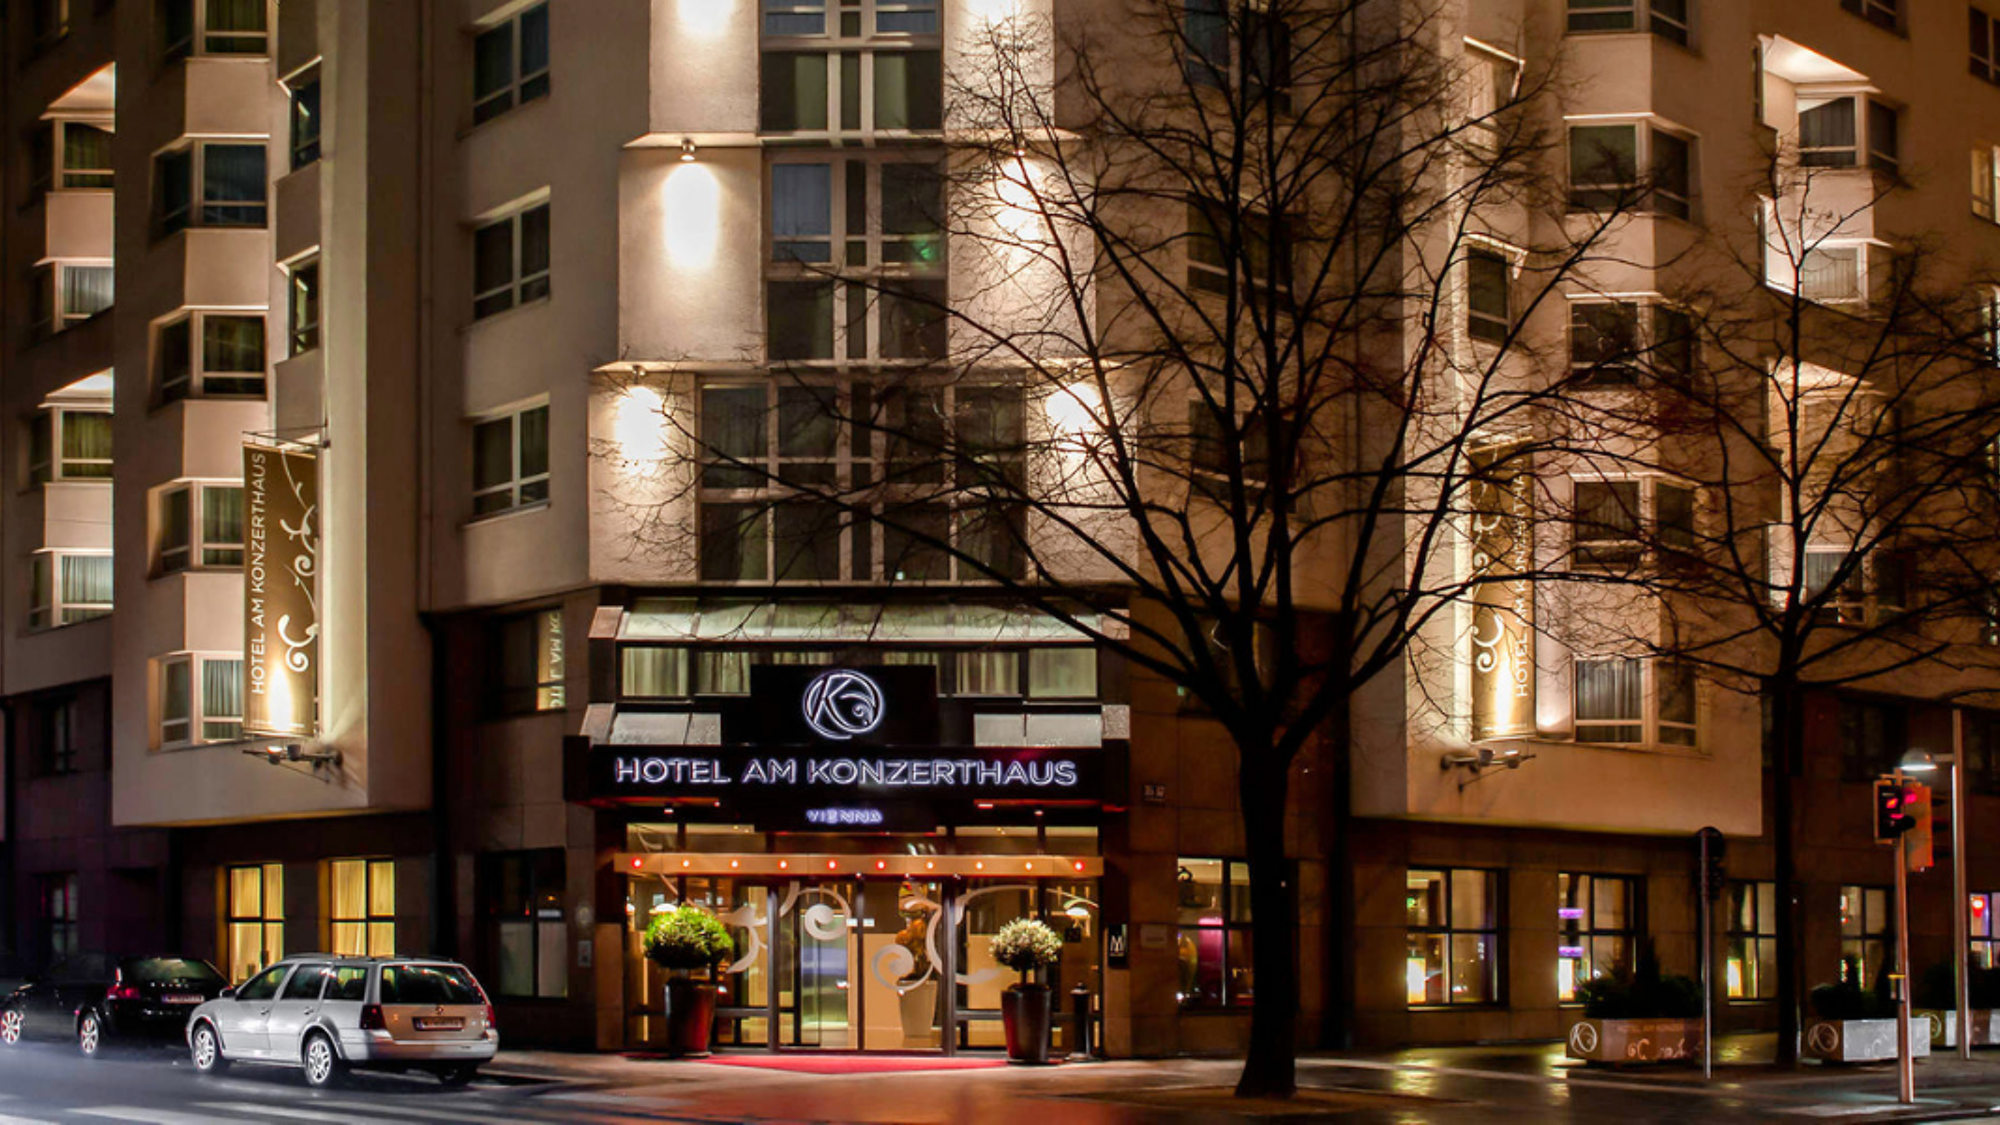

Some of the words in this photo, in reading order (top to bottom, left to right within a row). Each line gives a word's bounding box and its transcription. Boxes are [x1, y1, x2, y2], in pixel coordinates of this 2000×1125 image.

[251, 453, 266, 593] KONZERTHAUS
[251, 599, 265, 628] AM
[251, 632, 265, 694] HOTEL
[1515, 633, 1528, 697] HOTEL
[615, 756, 732, 785] HOTEL
[741, 758, 798, 786] AM
[807, 758, 1078, 787] KONZERTHAUS
[806, 808, 884, 825] VIENNA
